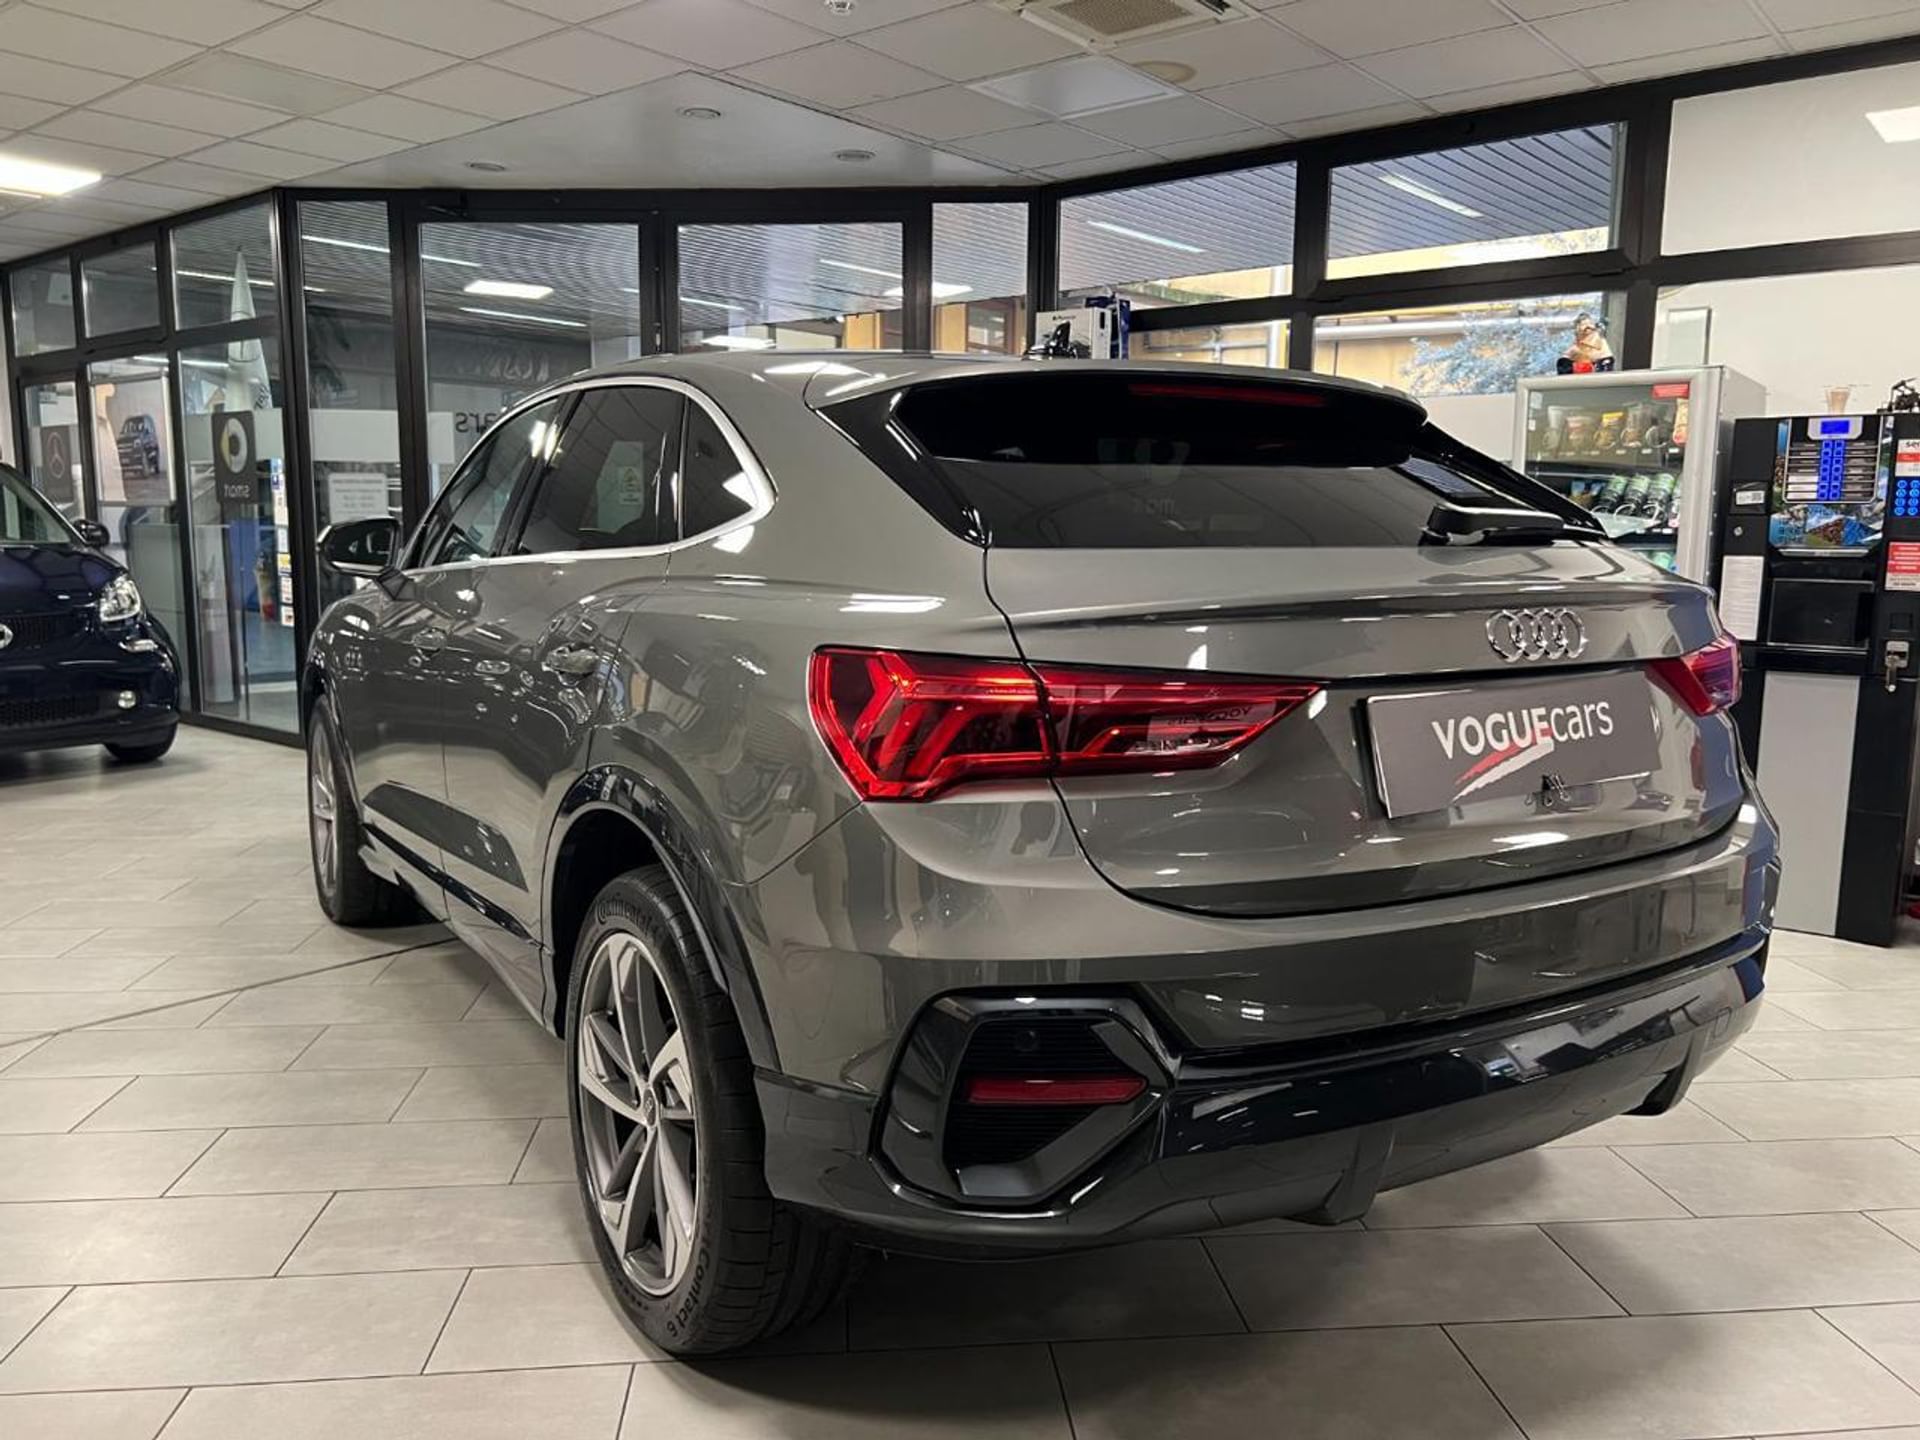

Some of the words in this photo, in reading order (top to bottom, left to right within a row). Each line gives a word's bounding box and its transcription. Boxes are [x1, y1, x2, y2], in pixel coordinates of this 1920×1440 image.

[1431, 700, 1615, 760] VOGUEcars
[675, 1247, 711, 1329] Contact
[666, 1320, 679, 1338] 6
